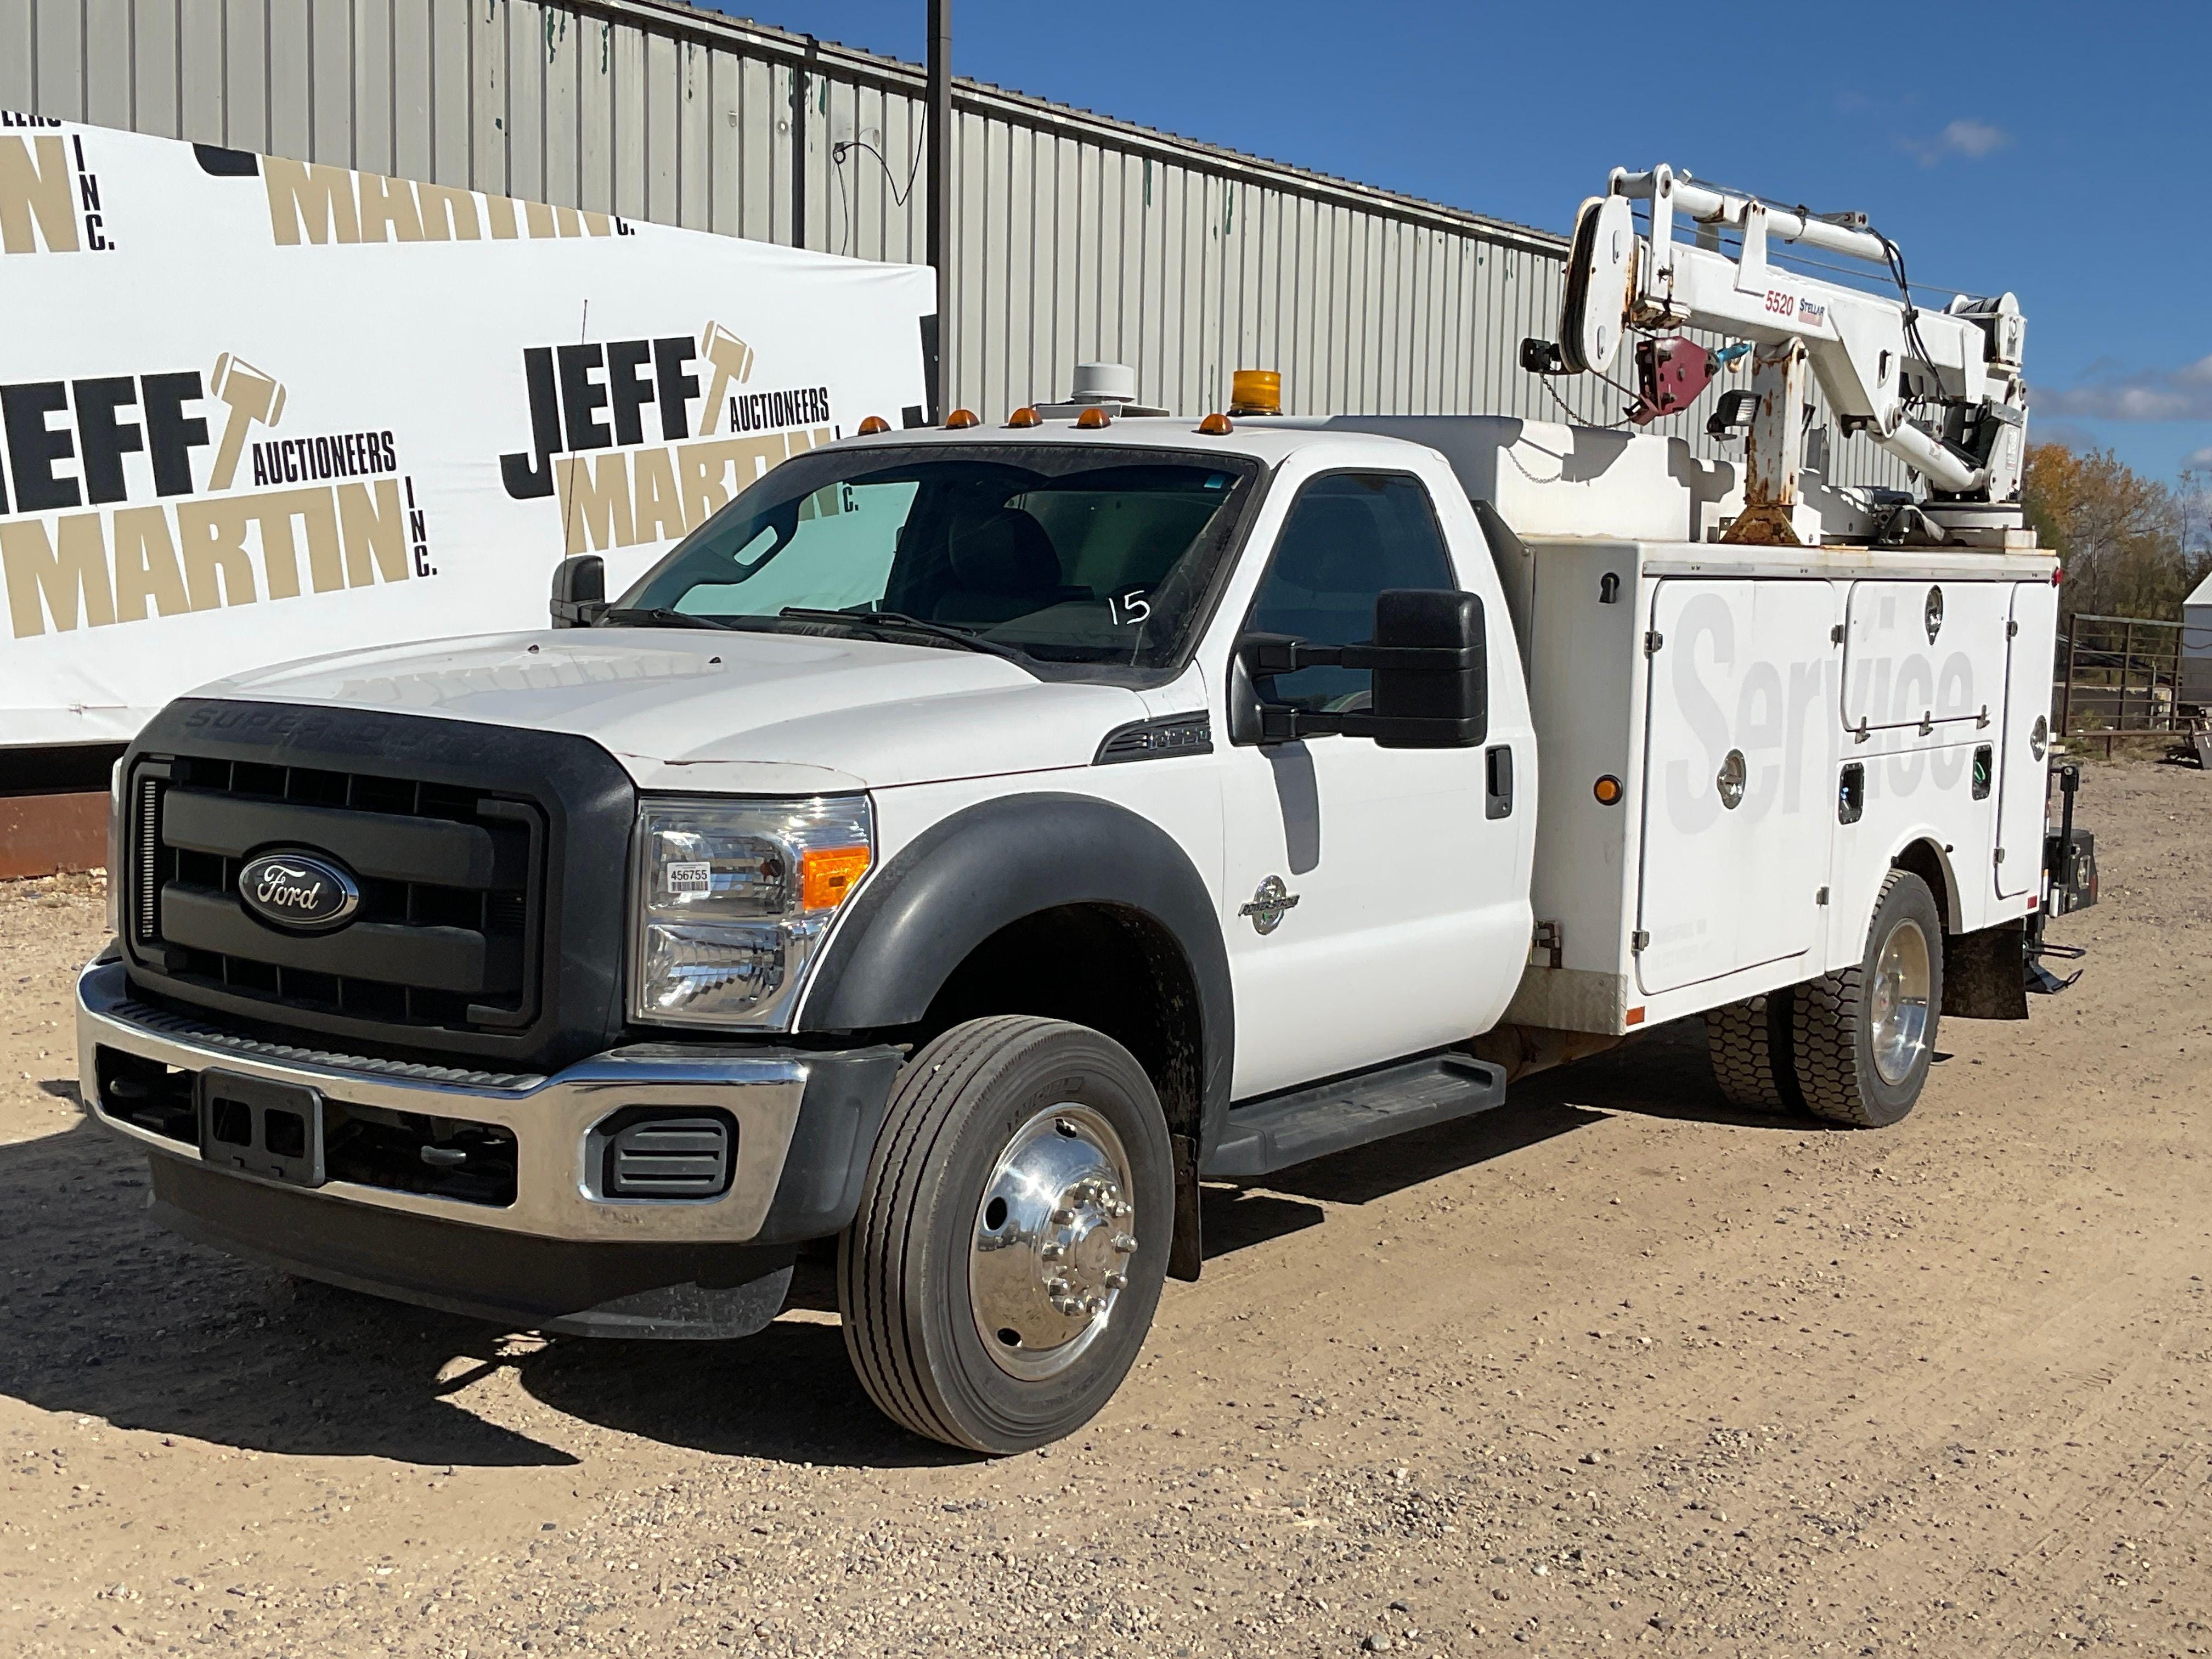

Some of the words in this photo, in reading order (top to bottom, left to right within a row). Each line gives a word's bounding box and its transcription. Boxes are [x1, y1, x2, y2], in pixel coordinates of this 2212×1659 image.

[1765, 290, 1793, 316] 5520
[1799, 298, 1825, 315] STELLAR
[499, 336, 701, 500] JEFF
[729, 387, 830, 433] AUCTIONEERS
[0, 371, 210, 515] EFF
[252, 431, 397, 487] AUCTIONEERS
[0, 479, 409, 639] MARTIN
[1109, 590, 1150, 625] 15
[1666, 592, 1974, 834] Service
[257, 865, 321, 910] Ford
[671, 870, 707, 880] 456755
